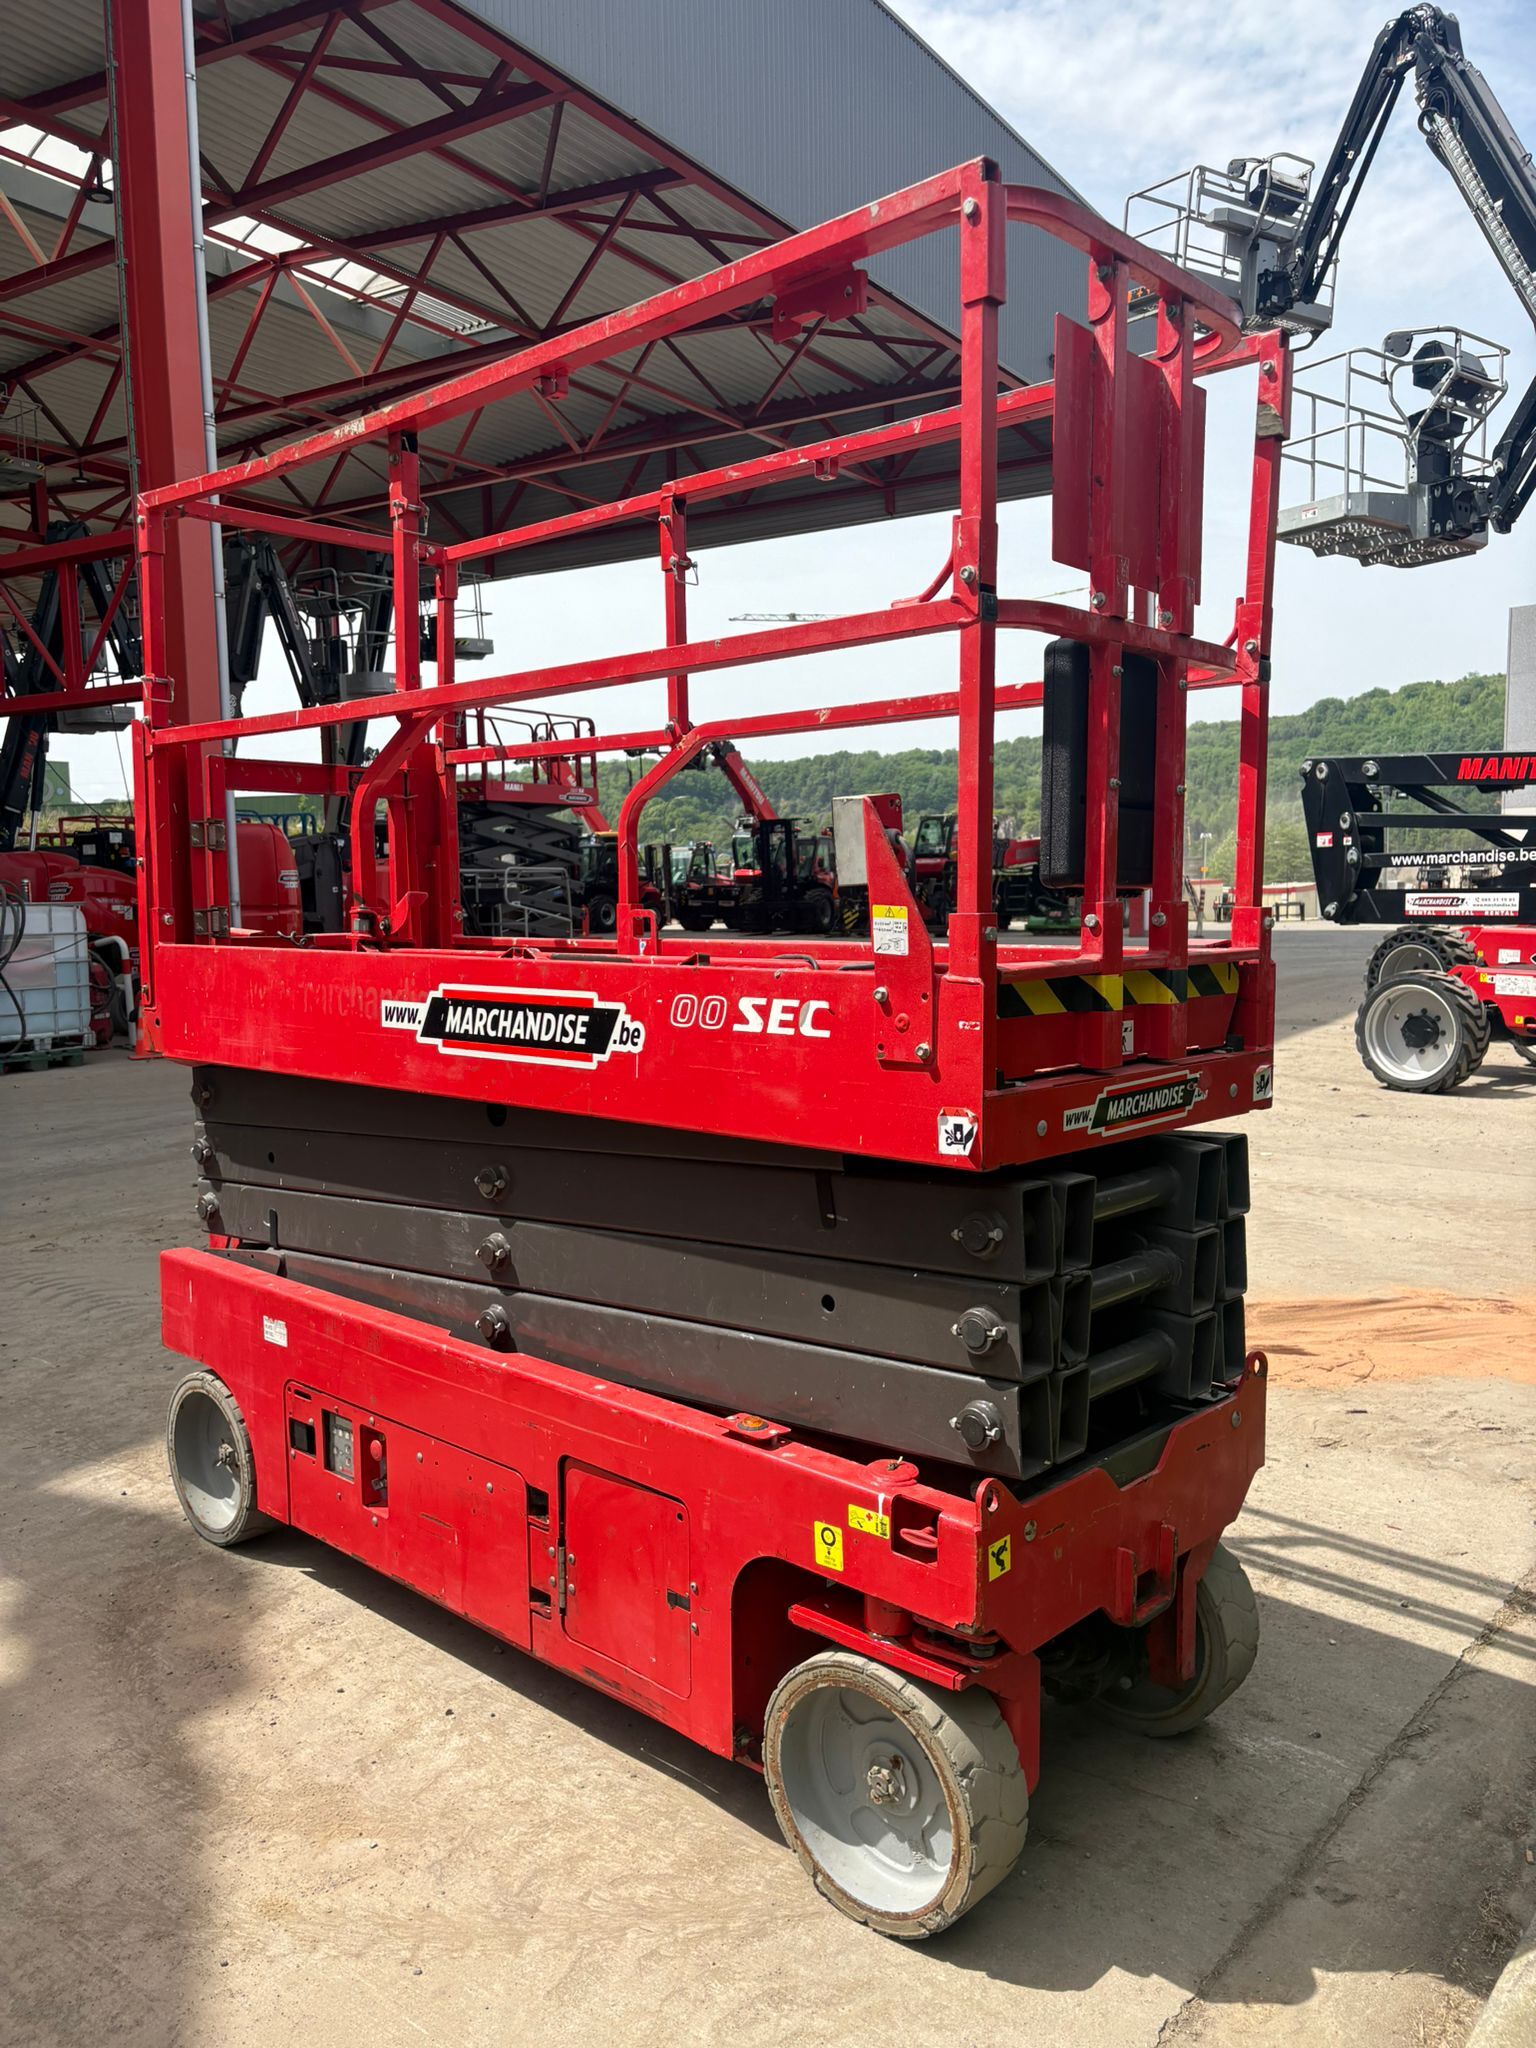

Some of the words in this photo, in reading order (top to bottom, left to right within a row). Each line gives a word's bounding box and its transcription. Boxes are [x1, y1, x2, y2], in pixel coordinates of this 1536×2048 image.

[1391, 848, 1536, 866] www.marchandise.be
[444, 1004, 591, 1046] MARCHANDISE
[732, 996, 832, 1039] SEC
[1106, 1084, 1186, 1121] MARCHANDISE
